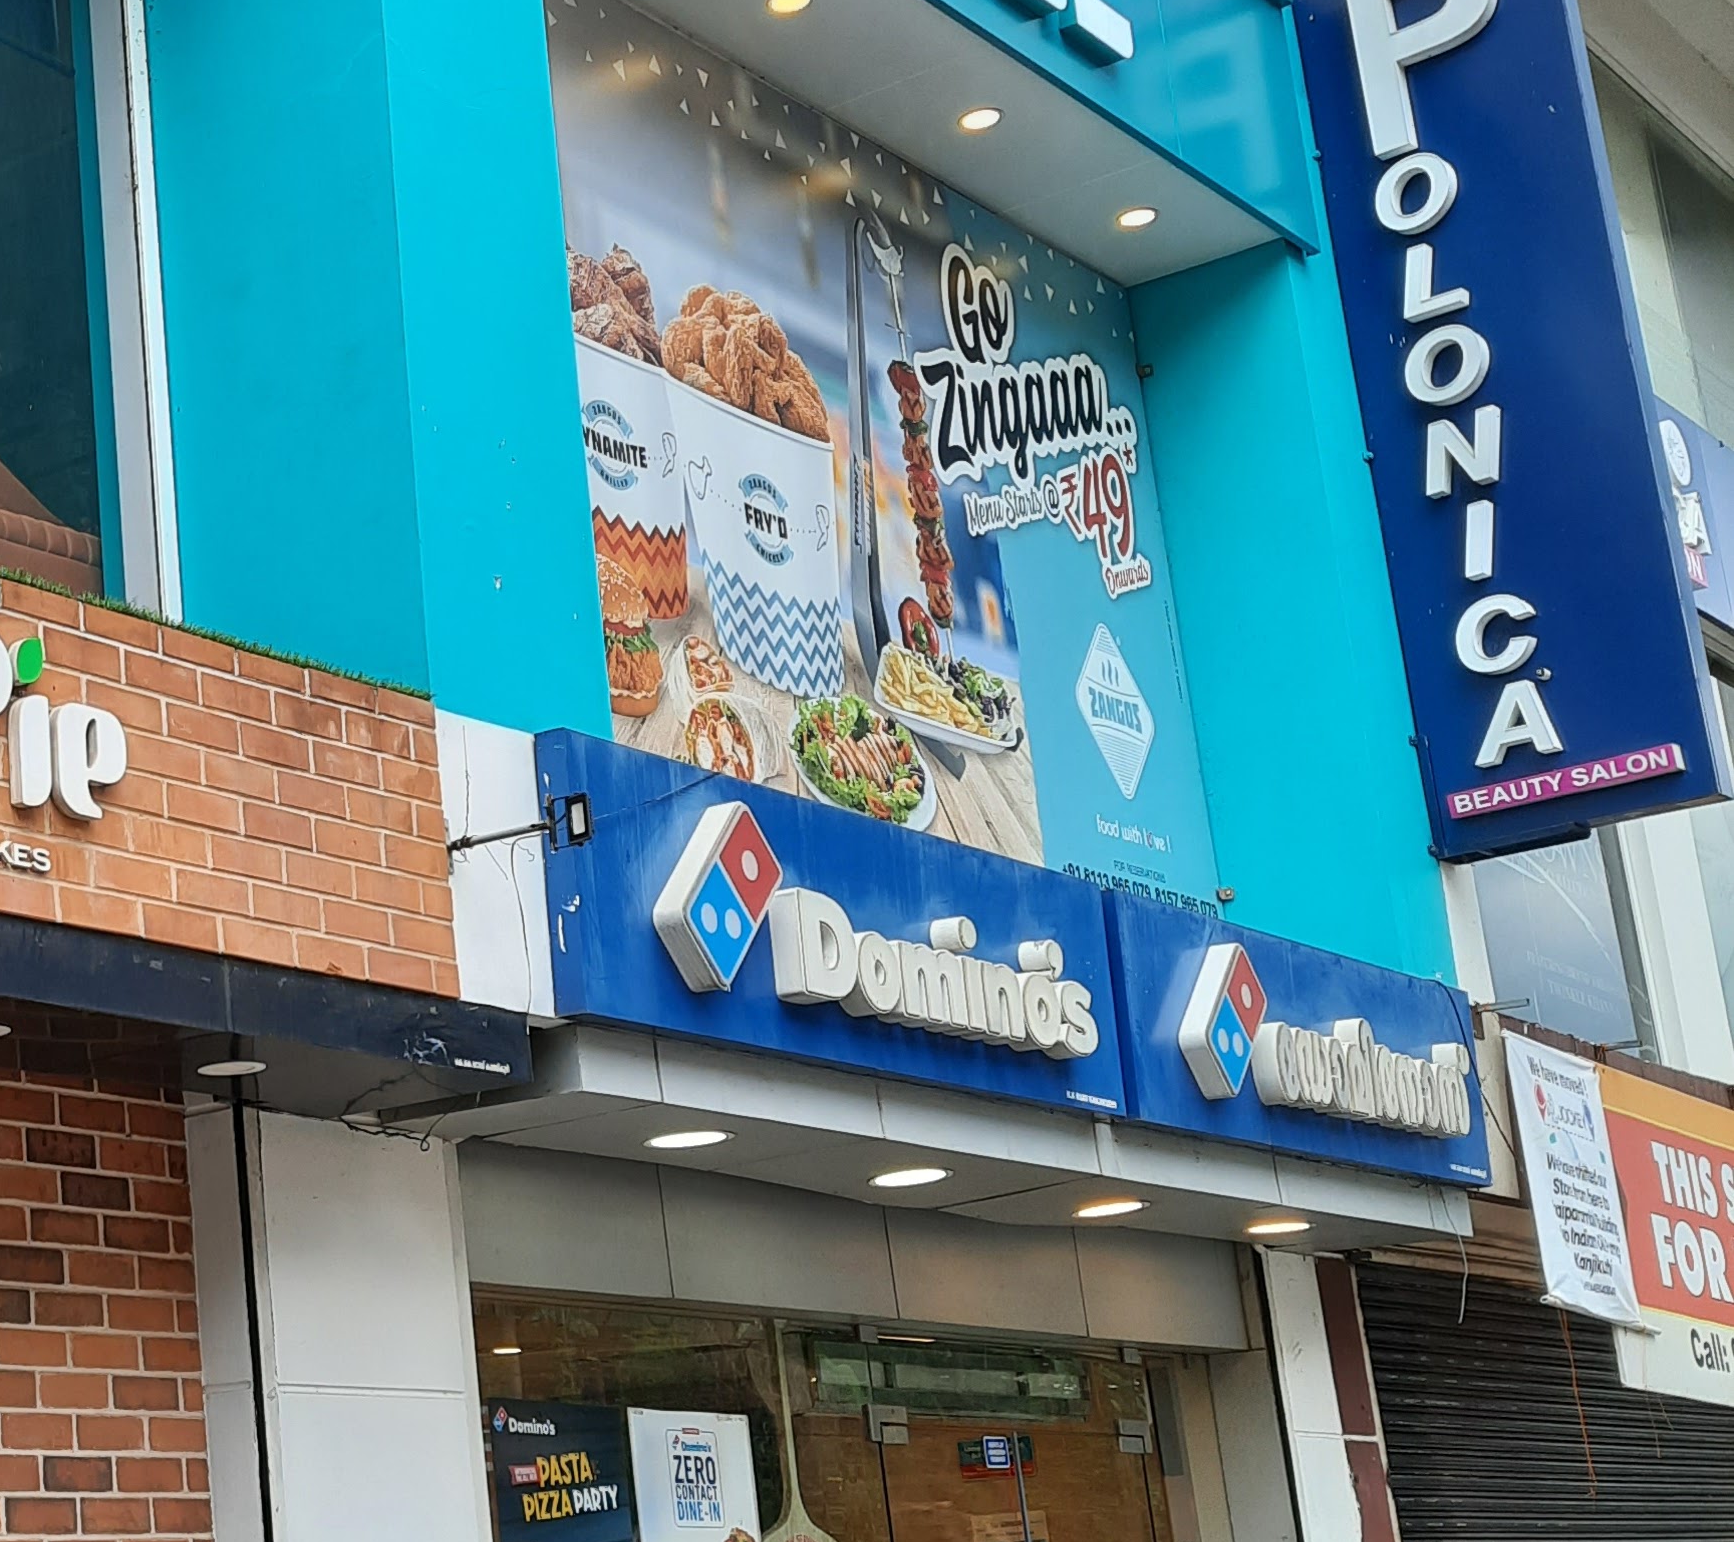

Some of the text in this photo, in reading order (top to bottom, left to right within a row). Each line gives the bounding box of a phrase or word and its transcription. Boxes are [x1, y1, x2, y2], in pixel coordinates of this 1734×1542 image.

[744, 501, 788, 540] FRY'D
[968, 493, 1004, 534] Menu
[1005, 487, 1043, 523] Starts
[1106, 558, 1150, 596] Onwards
[1088, 686, 1143, 735] ZANGOS
[1453, 747, 1669, 814] BEAUTY SALON
[1096, 813, 1120, 839] food
[1121, 824, 1143, 843] with
[769, 887, 1099, 1059] Domino's
[1650, 1140, 1719, 1219] THIS
[1650, 1212, 1734, 1304] FOR
[508, 1416, 556, 1436] Domino's
[536, 1451, 594, 1488] PASTA
[673, 1454, 717, 1485] ZERO
[522, 1483, 618, 1522] PIZZA PARTY
[675, 1483, 718, 1501] CONTACT
[677, 1500, 722, 1522] DINE-IN
